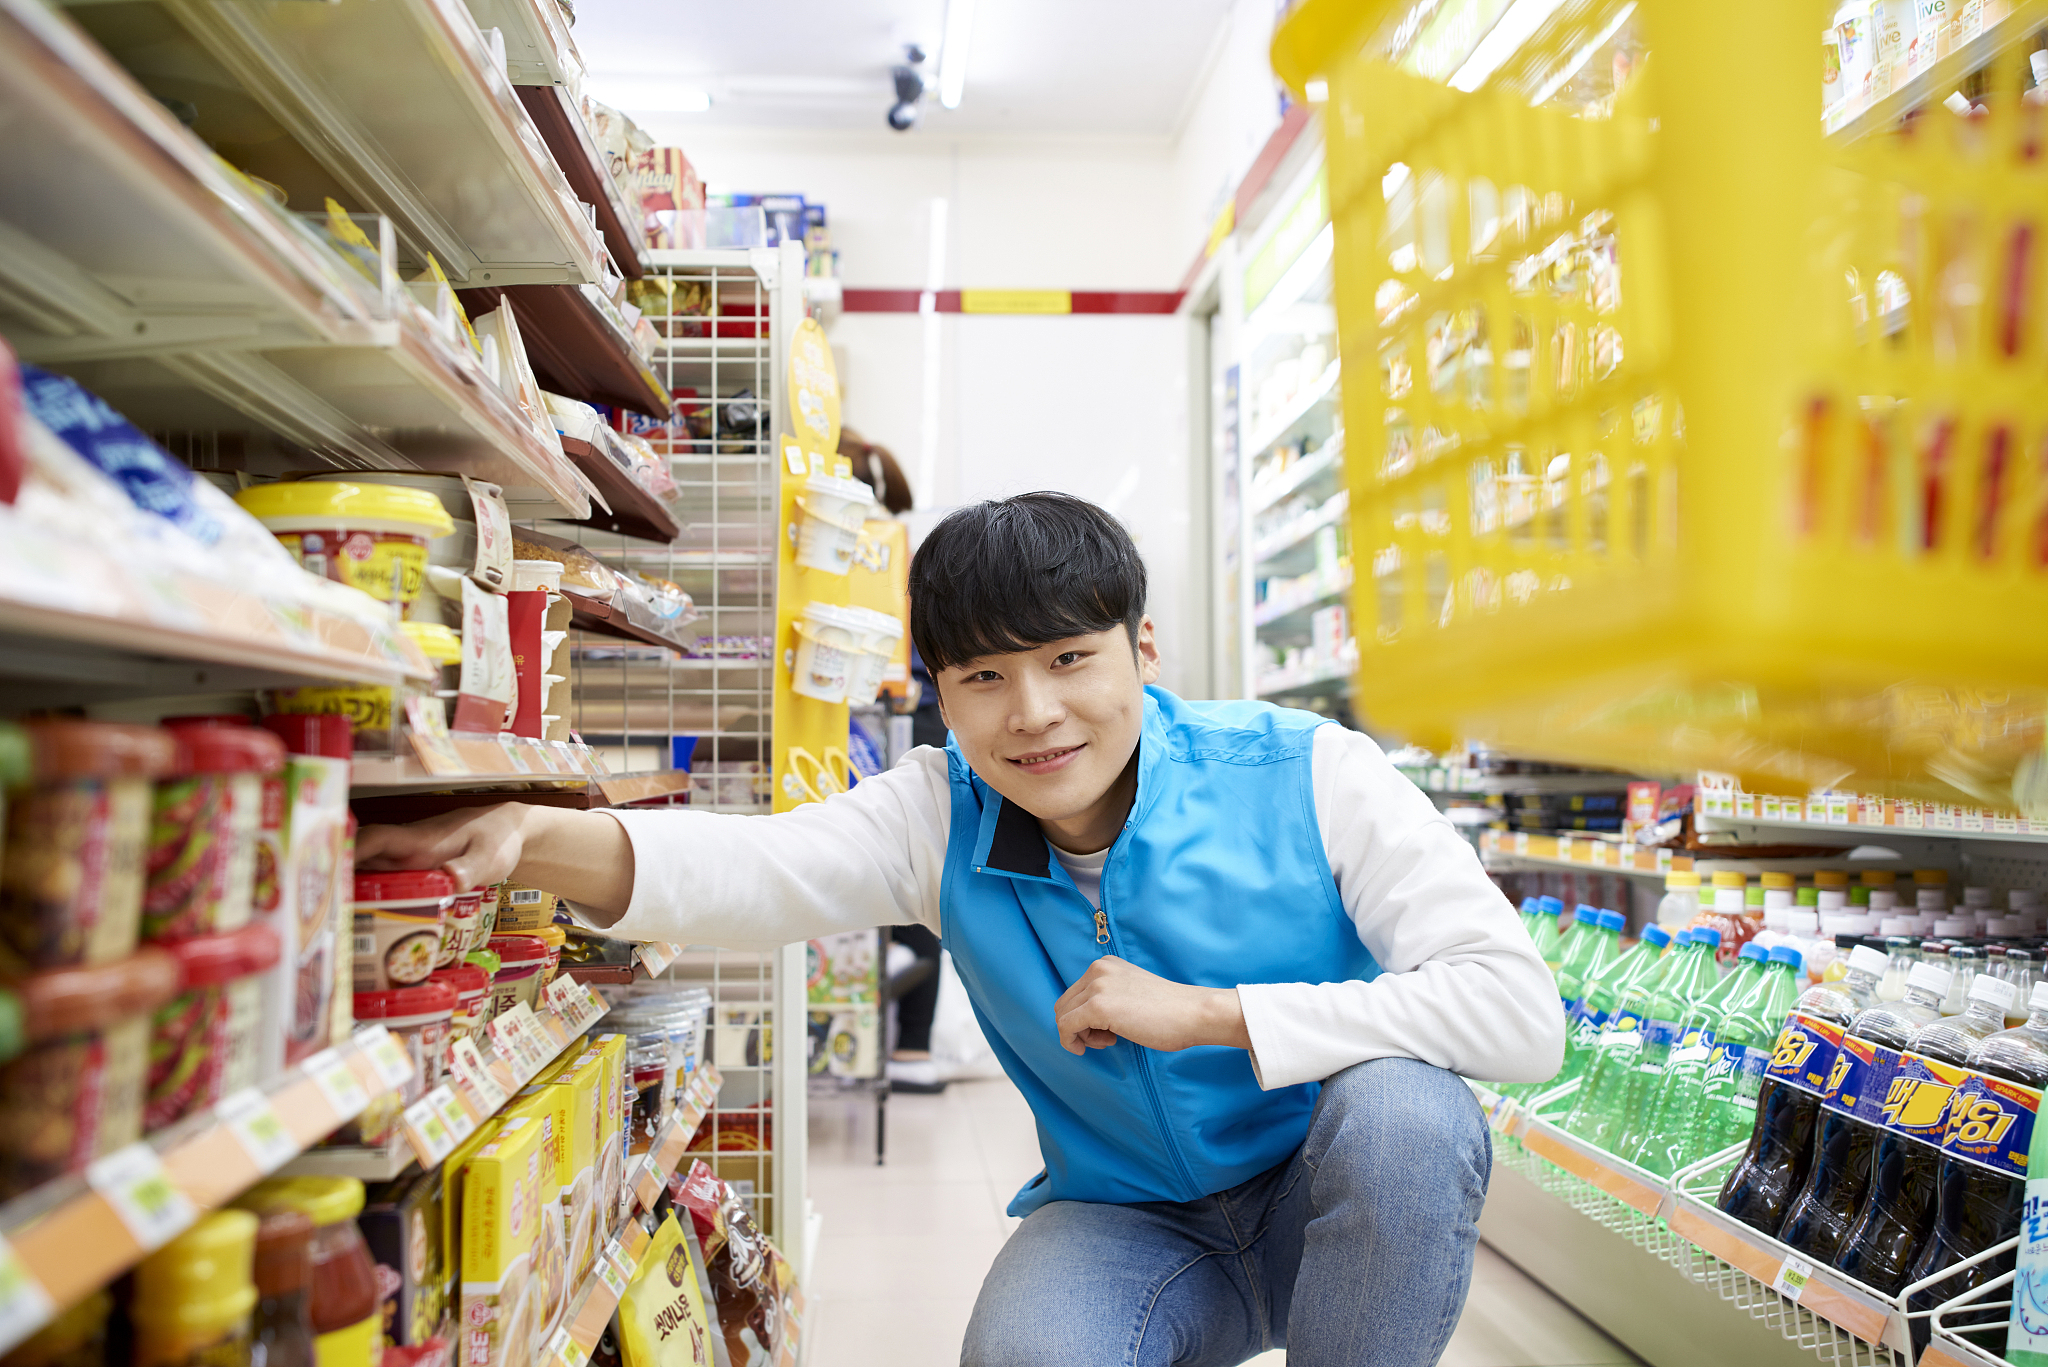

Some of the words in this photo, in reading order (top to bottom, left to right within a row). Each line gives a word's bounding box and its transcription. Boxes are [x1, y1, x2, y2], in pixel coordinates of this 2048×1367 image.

[1919, 0, 1945, 19] live
[1803, 1018, 1820, 1032] SPARK
[1819, 1026, 1831, 1037] UP!
[1994, 1084, 2018, 1098] SPARK
[2017, 1093, 2031, 1106] UP!
[1905, 1127, 1928, 1135] VITAMIN
[655, 1294, 691, 1342] 씻어나온
